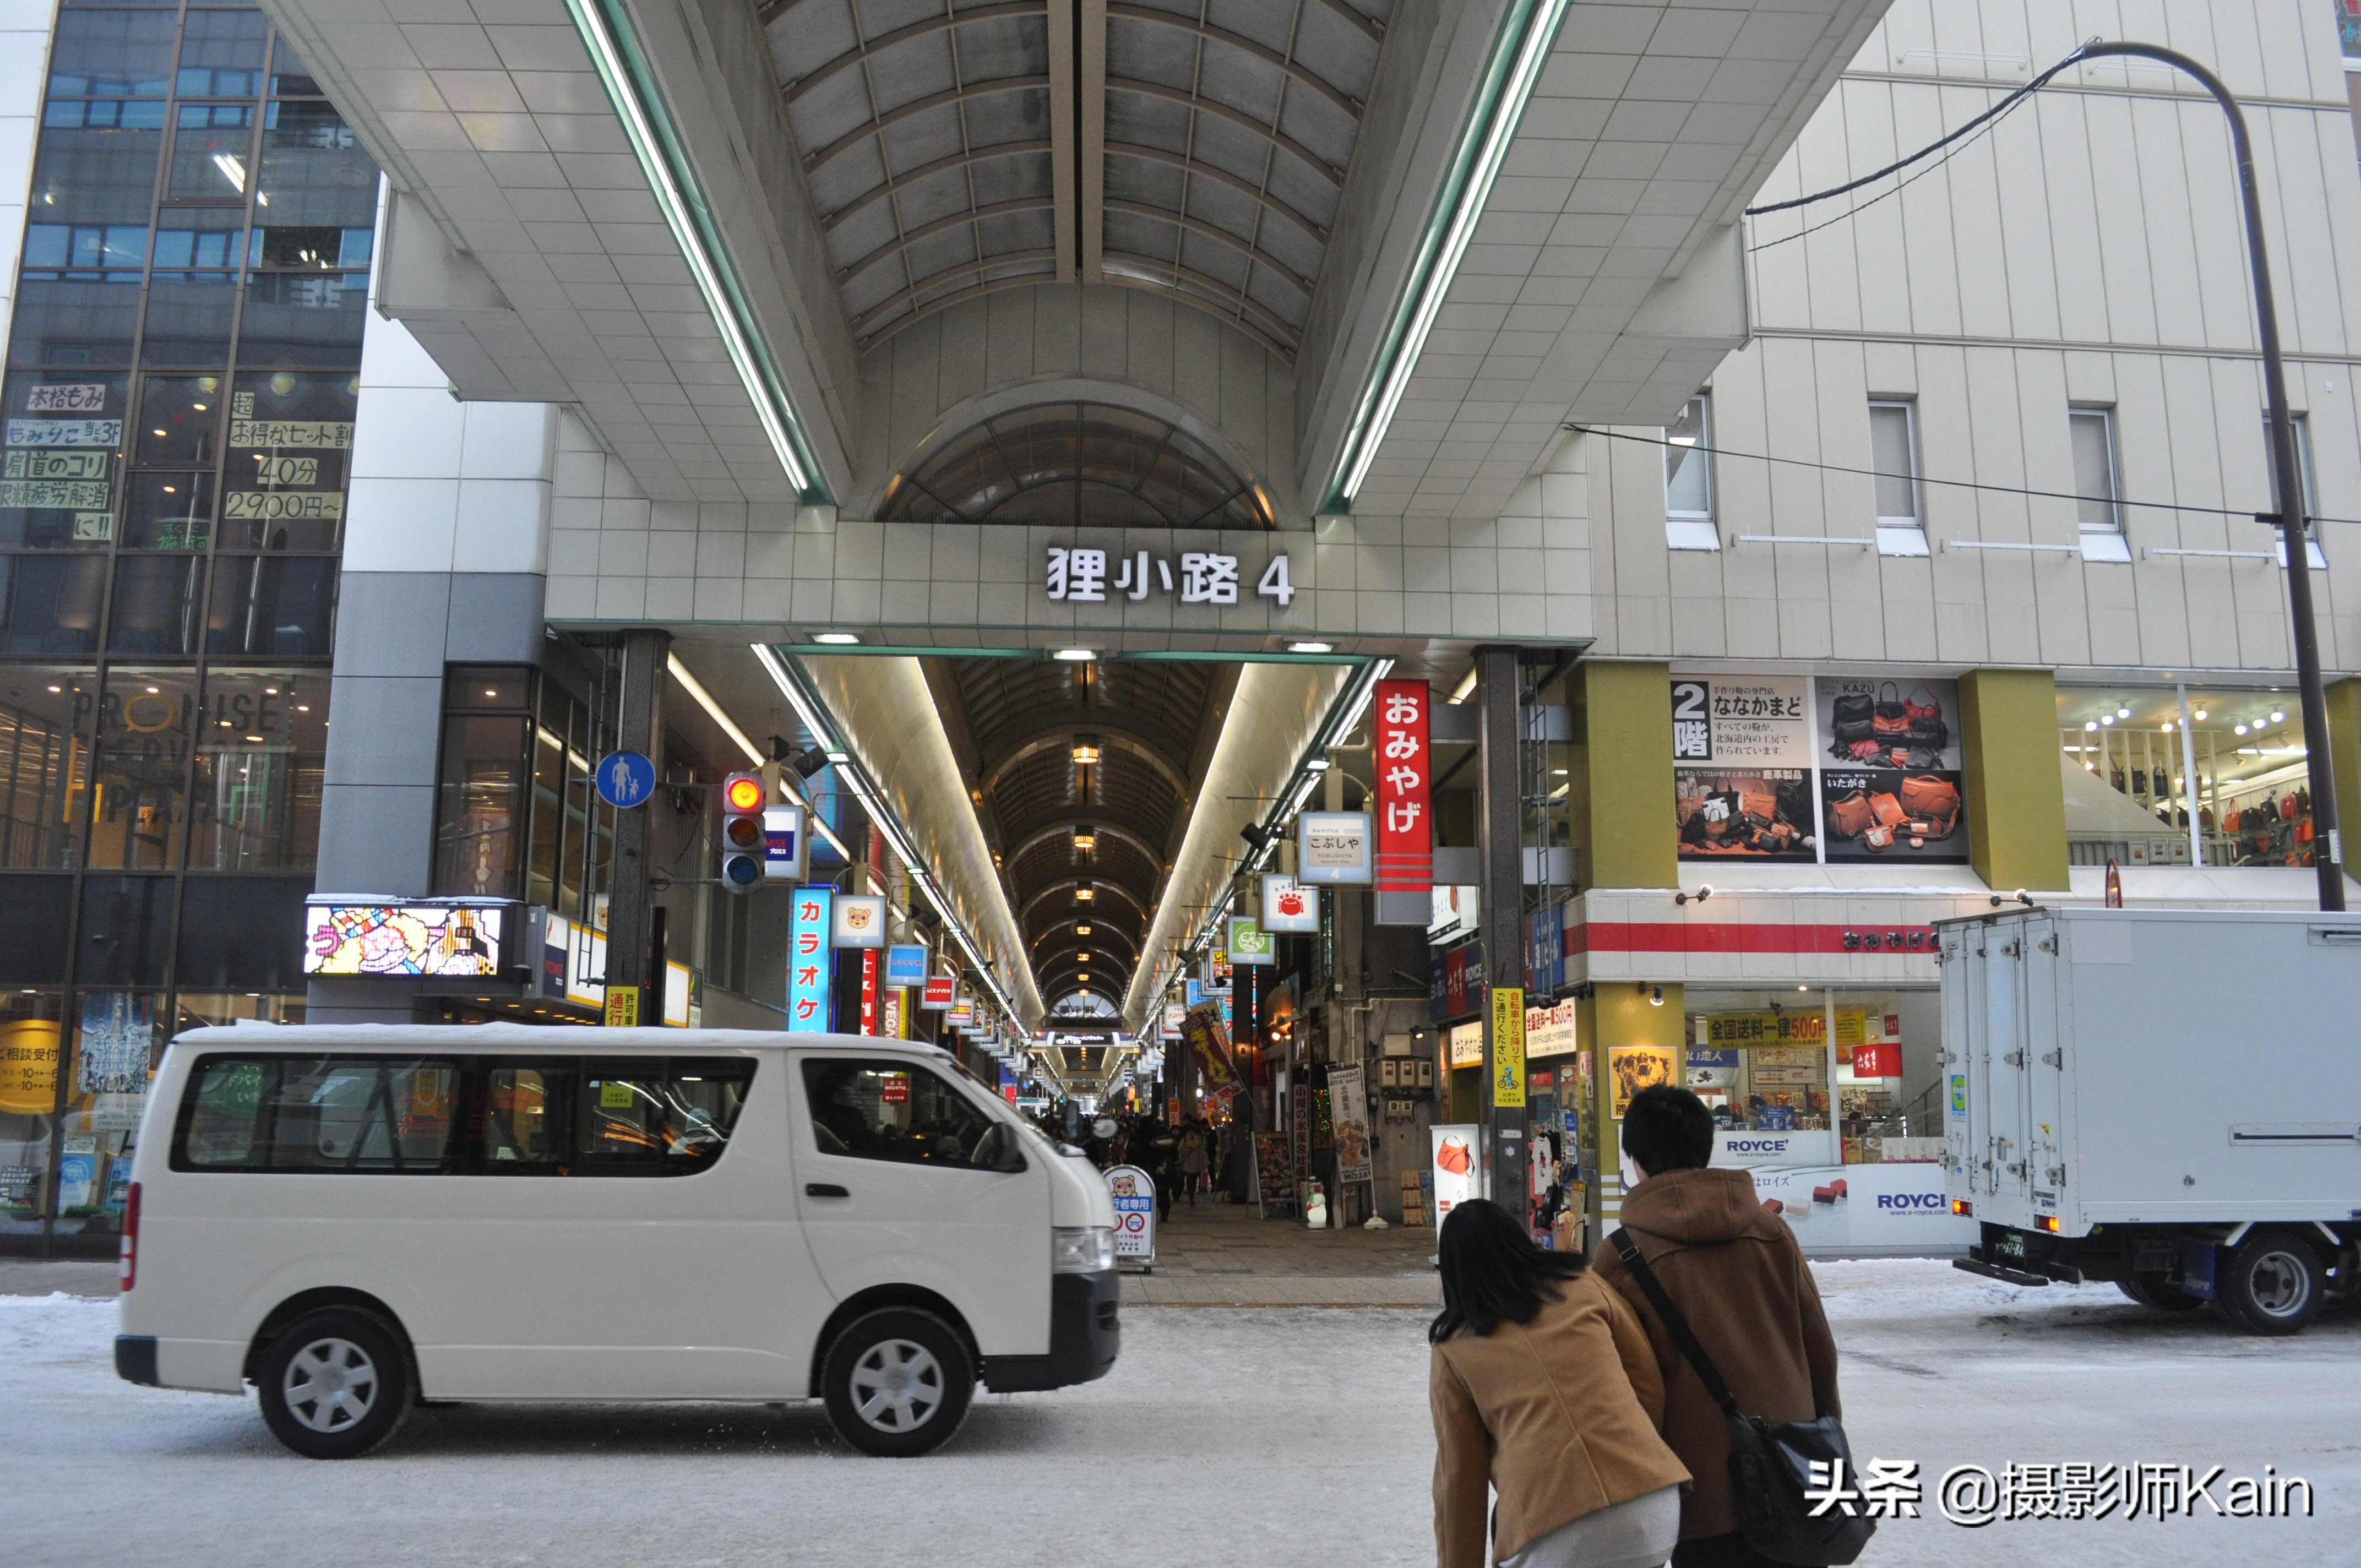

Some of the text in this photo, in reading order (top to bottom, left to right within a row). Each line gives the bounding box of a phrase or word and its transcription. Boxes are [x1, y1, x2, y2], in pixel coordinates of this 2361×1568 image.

[30, 386, 103, 408] 本格もみ
[232, 394, 253, 416] 超
[9, 427, 79, 444] もみりこ
[232, 422, 353, 448] お得なセット割
[7, 452, 105, 477] 肩 首のコリ
[258, 459, 317, 484] 40分
[1047, 548, 1295, 606] 狸小路 4
[1713, 687, 1775, 695] 手作り鞄の専門店
[1843, 684, 1875, 693] KAZU
[1714, 696, 1801, 716] ななかまど
[1673, 683, 1708, 757] 2階
[1715, 722, 1774, 732] すべての鞄が、
[1716, 734, 1788, 744] 北海道内の工房で
[1716, 746, 1783, 756] 作られています。
[1385, 693, 1420, 834] おみやげ
[1762, 770, 1803, 780] 鹿革製品
[1827, 778, 1867, 788] いたがき
[1311, 838, 1359, 849] こぶしや
[1331, 869, 1340, 879] 4
[796, 901, 820, 1020] カラオケ
[609, 993, 623, 1026] 通行
[624, 993, 635, 1026] 許可車
[1496, 993, 1506, 1065] ご通行ください
[1510, 992, 1521, 1064] 自転車から降りて
[1711, 1017, 1827, 1041] 全国送料一律500円
[1727, 1139, 1788, 1151] ROYCE'
